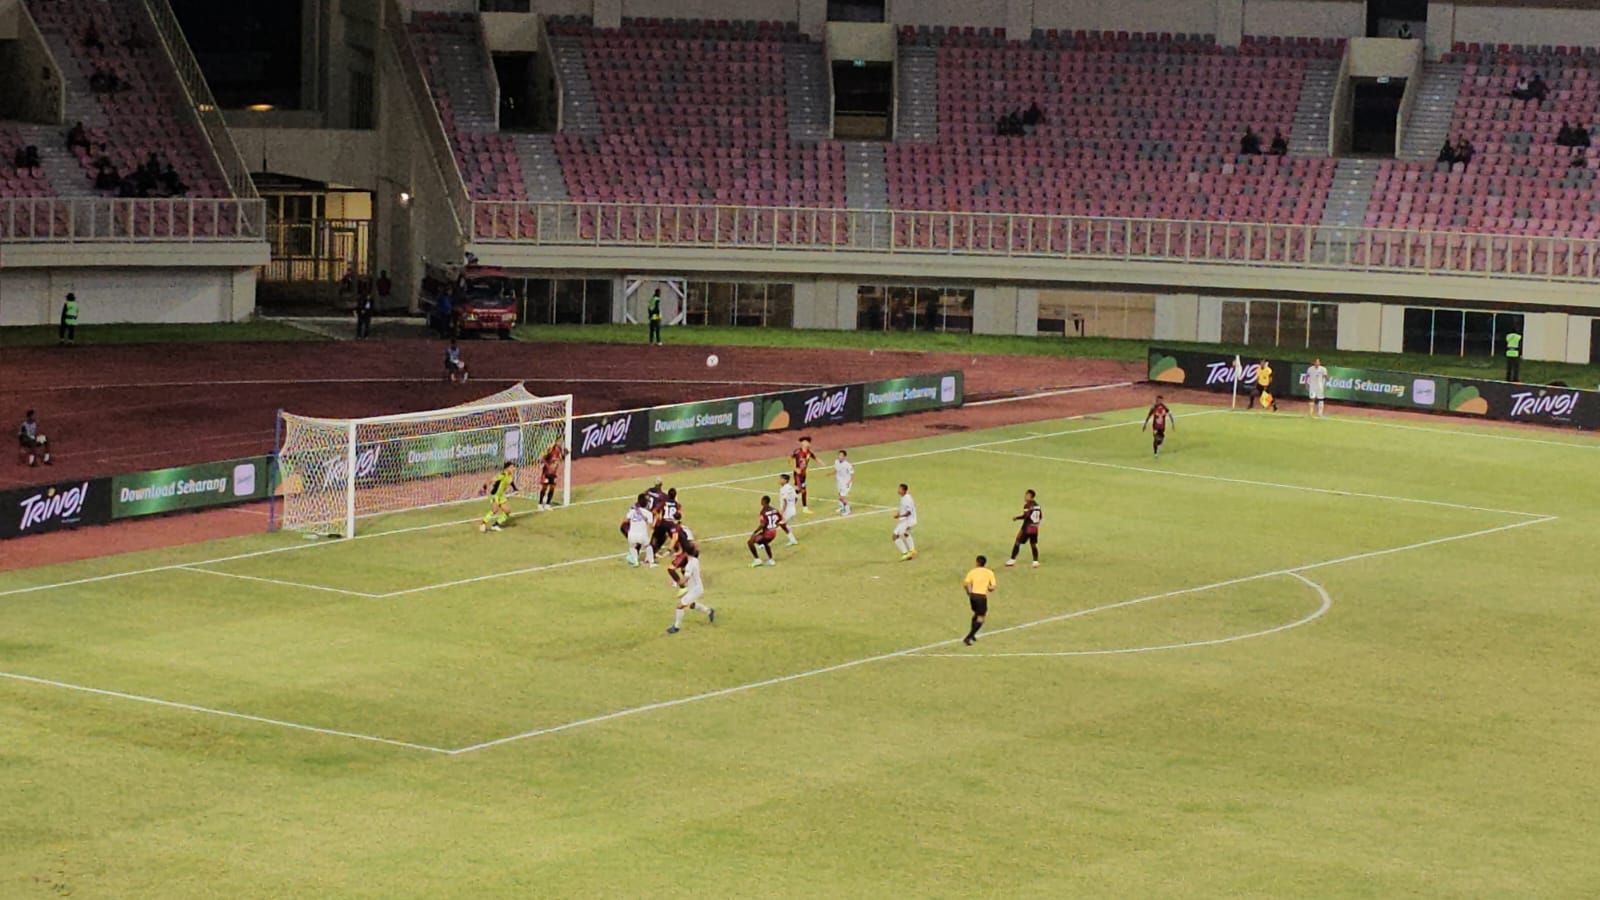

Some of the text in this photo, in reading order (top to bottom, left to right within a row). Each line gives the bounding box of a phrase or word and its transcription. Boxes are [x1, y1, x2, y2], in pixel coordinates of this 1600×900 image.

[867, 391, 904, 405] Download
[1354, 379, 1405, 397] Sekarang
[654, 411, 733, 433] Download Sekarang
[120, 482, 175, 503] Download
[176, 477, 227, 496] Sekarang
